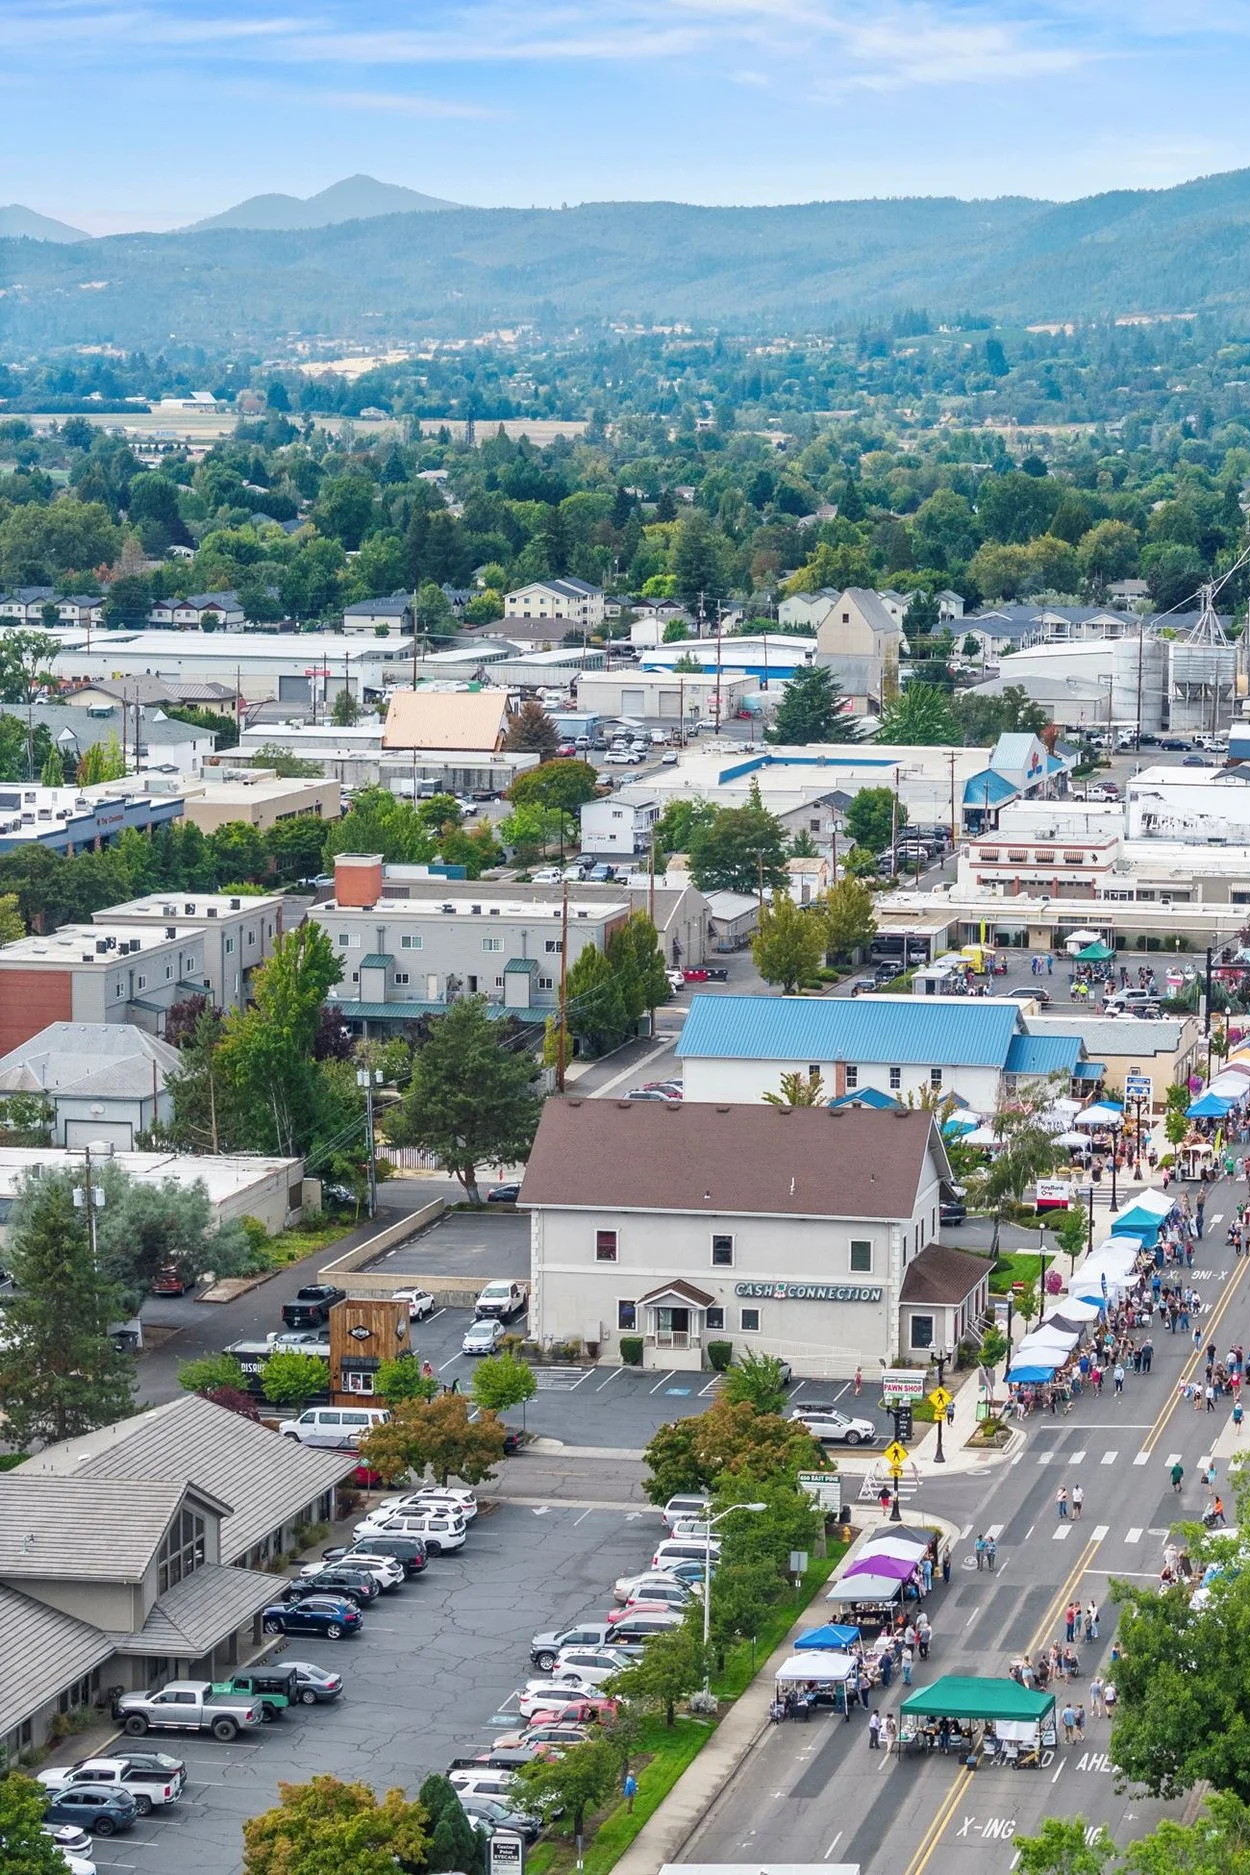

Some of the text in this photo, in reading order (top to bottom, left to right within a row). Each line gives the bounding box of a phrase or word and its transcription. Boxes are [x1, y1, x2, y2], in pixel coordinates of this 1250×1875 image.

[735, 1282, 883, 1302] CASH CONNECTION
[884, 1384, 923, 1393] PAWN SHOP
[1076, 1752, 1123, 1773] AHE
[956, 1816, 1017, 1840] X-ING
